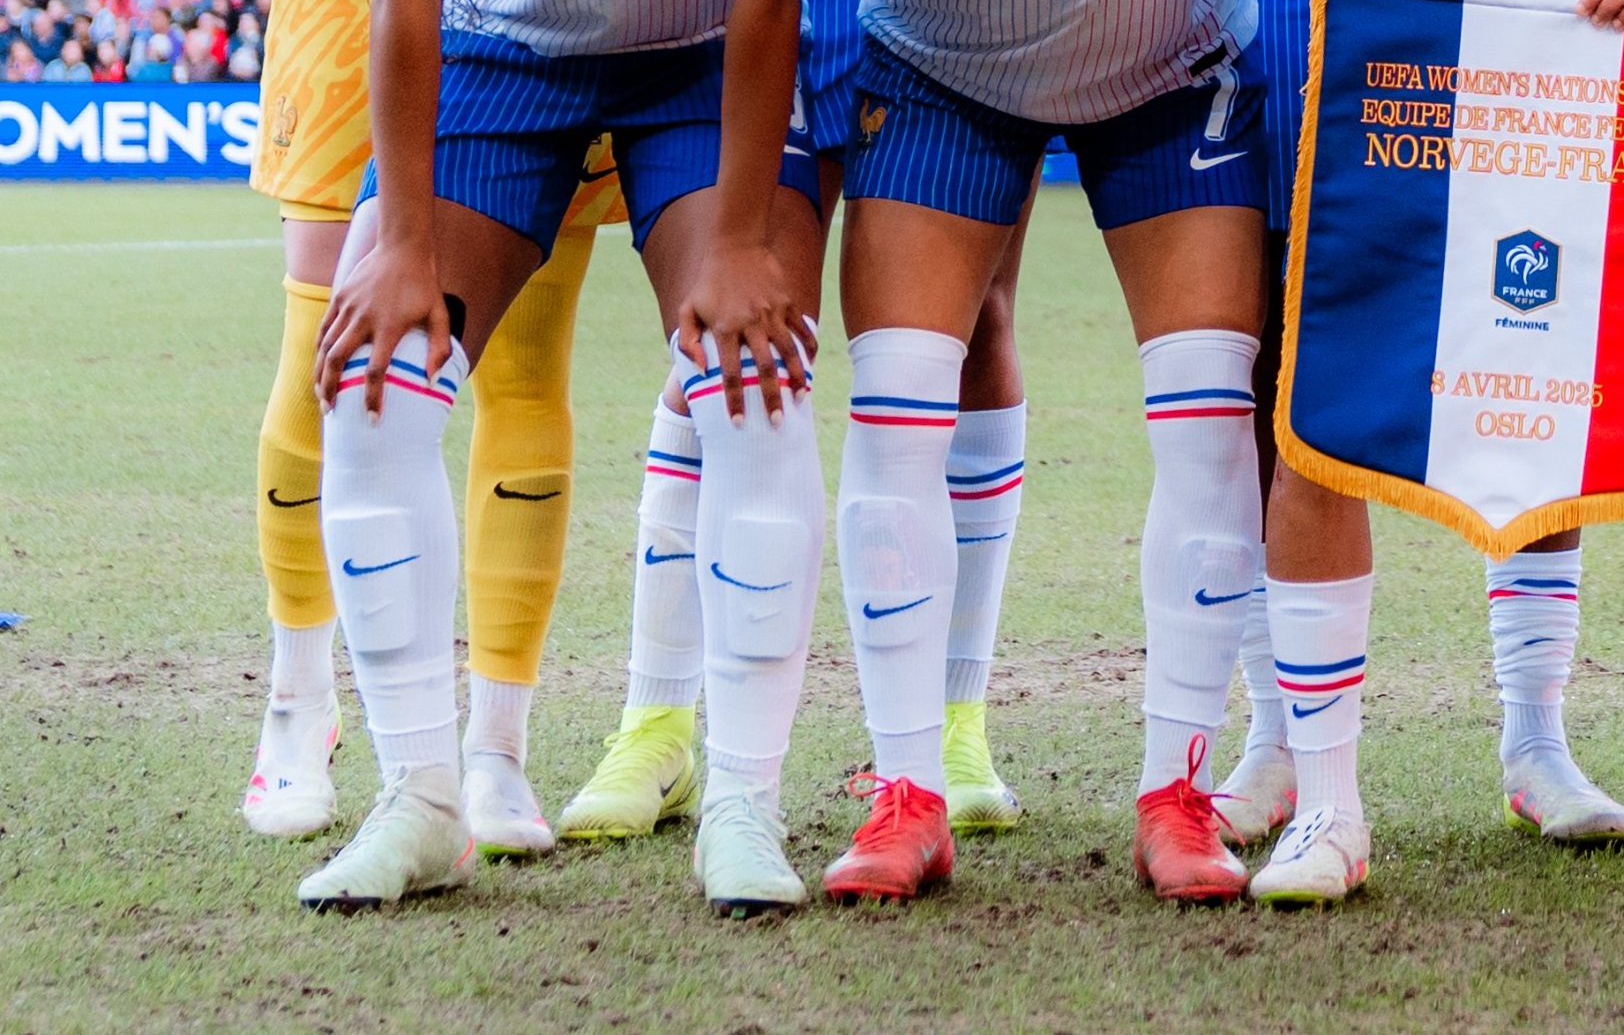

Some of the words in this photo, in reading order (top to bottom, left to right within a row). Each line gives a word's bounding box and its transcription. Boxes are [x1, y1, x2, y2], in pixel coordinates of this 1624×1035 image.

[1365, 62, 1424, 90] UEFA
[1426, 65, 1531, 98] WOMEN'S
[1360, 98, 1452, 128] EQUIPE
[1454, 105, 1489, 131] DE
[1491, 107, 1592, 139] FRANCE
[1502, 286, 1548, 299] FRANCE
[1494, 317, 1550, 332] FÉMININE
[1431, 370, 1446, 395] 8
[1450, 371, 1541, 402] AVRIL
[1545, 378, 1604, 408] 2025
[1474, 410, 1556, 441] OSLO
